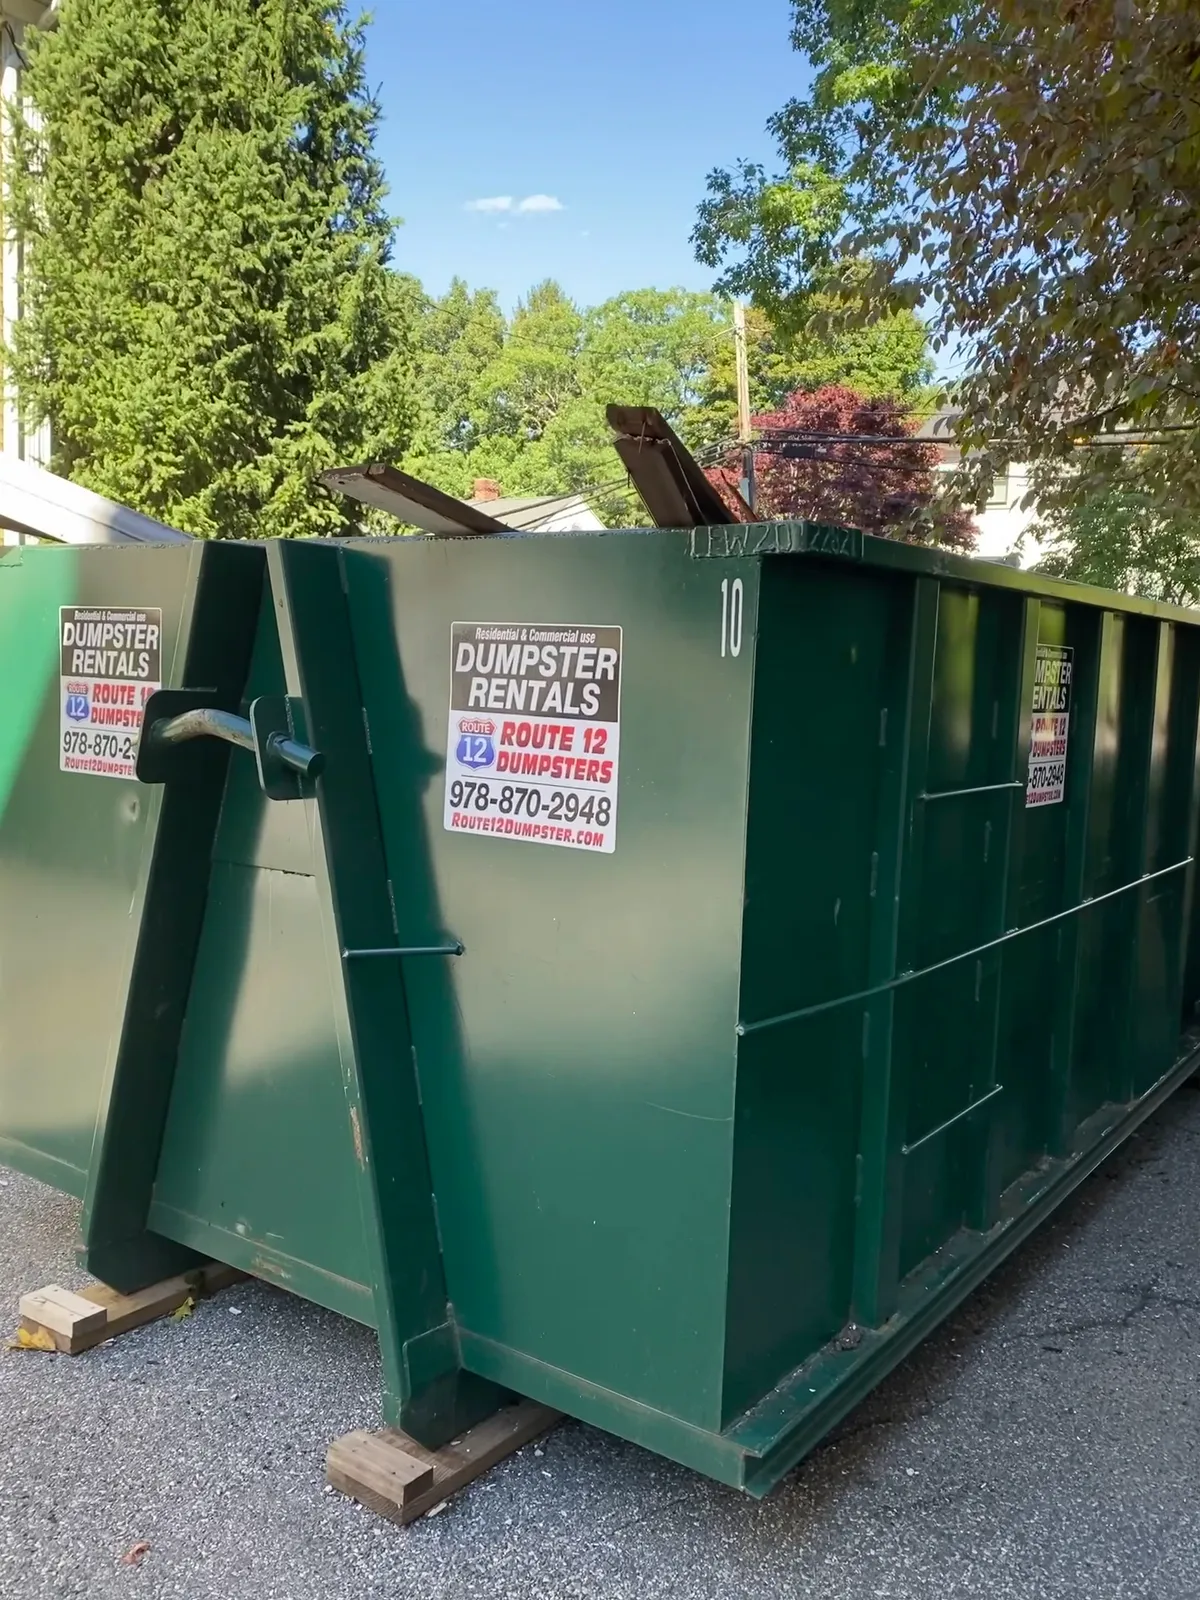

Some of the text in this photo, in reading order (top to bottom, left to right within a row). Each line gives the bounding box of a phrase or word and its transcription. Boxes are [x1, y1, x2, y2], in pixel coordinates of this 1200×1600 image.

[721, 577, 743, 658] 10
[63, 622, 159, 650] DUMPSTER
[475, 627, 596, 644] Residential & Commercial use
[72, 648, 149, 678] RENTALS
[455, 642, 618, 681] DUMPSTER
[68, 684, 88, 694] ROUTE
[92, 683, 136, 706] ROUTE
[468, 676, 601, 716] RENTALS
[69, 696, 85, 716] 12
[461, 721, 491, 735] ROUTE
[500, 721, 608, 755] ROUTE 12
[63, 730, 136, 761] 978-870-2
[462, 737, 488, 763] 12
[496, 751, 613, 784] DUMPSTERS
[449, 780, 612, 827] 978-870-2948
